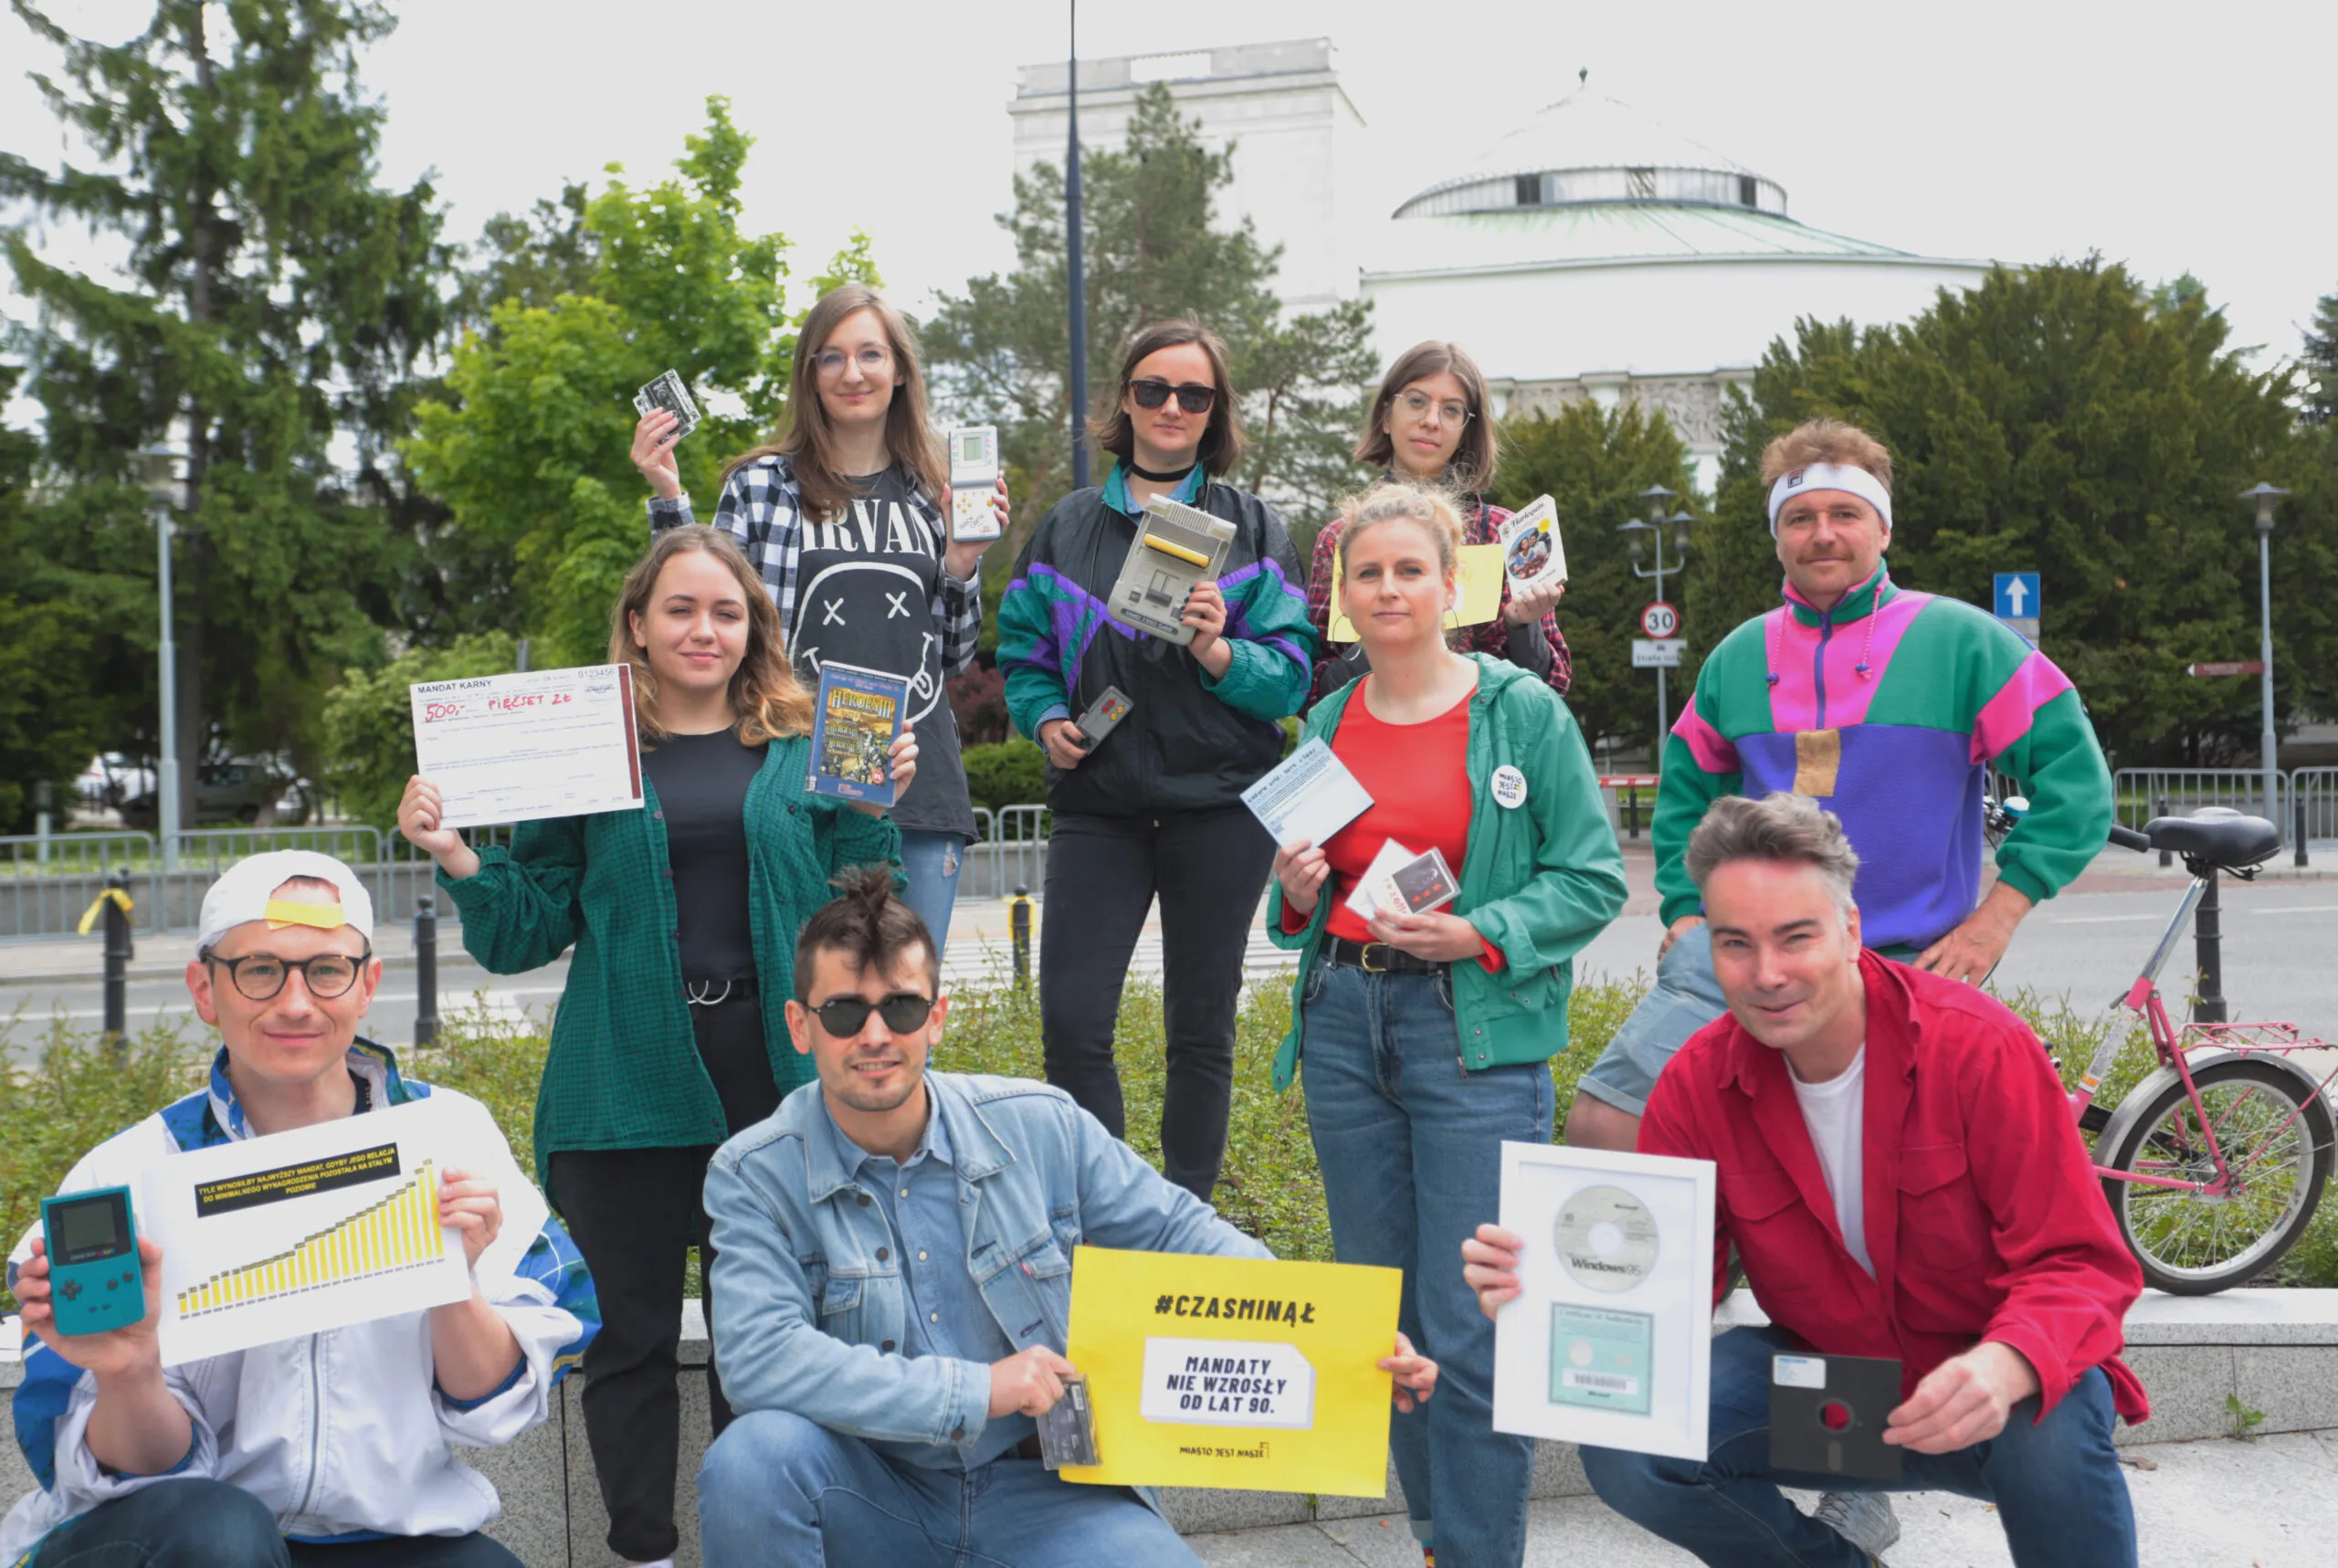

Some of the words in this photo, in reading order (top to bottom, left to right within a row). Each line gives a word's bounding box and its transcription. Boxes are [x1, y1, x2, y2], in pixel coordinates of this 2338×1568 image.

[1648, 612, 1674, 631] 30
[417, 683, 457, 694] MANDAT
[459, 679, 492, 690] KARNY
[831, 689, 878, 711] HEROES
[198, 1185, 216, 1195] TYLE
[349, 1154, 366, 1164] JEGO
[366, 1148, 395, 1160] RELACJA
[203, 1194, 214, 1204] DO
[1154, 1294, 1315, 1328] #CZASMINĄŁ
[1185, 1356, 1271, 1375] MANDATY
[1166, 1374, 1196, 1391] NIE
[1204, 1376, 1287, 1395] WZROSŁY
[1180, 1394, 1203, 1410] OD
[1208, 1395, 1243, 1412] LAT
[1248, 1397, 1275, 1415] 90.
[1179, 1446, 1213, 1457] MIASTO
[1215, 1447, 1235, 1458] JEST
[1237, 1448, 1265, 1458] NASZE
